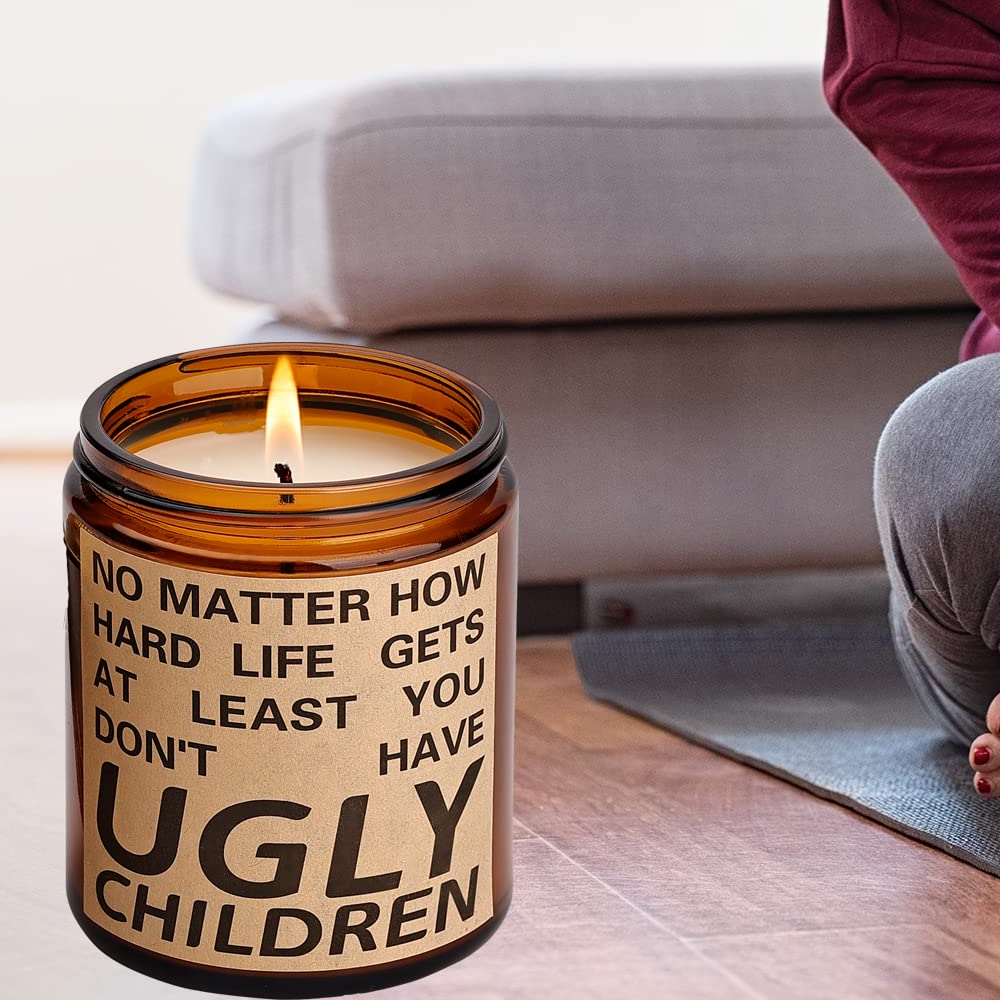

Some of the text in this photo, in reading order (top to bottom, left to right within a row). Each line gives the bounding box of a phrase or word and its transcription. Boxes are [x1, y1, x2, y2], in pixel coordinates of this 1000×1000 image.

[92, 550, 486, 626] NO MATTER HOW
[93, 602, 484, 679] HARD LIFE GETS
[94, 656, 485, 732] AT LEAST YOU
[95, 705, 485, 777] DON'T HAVE
[96, 754, 486, 900] UGLY
[95, 864, 480, 958] CHILDREN
